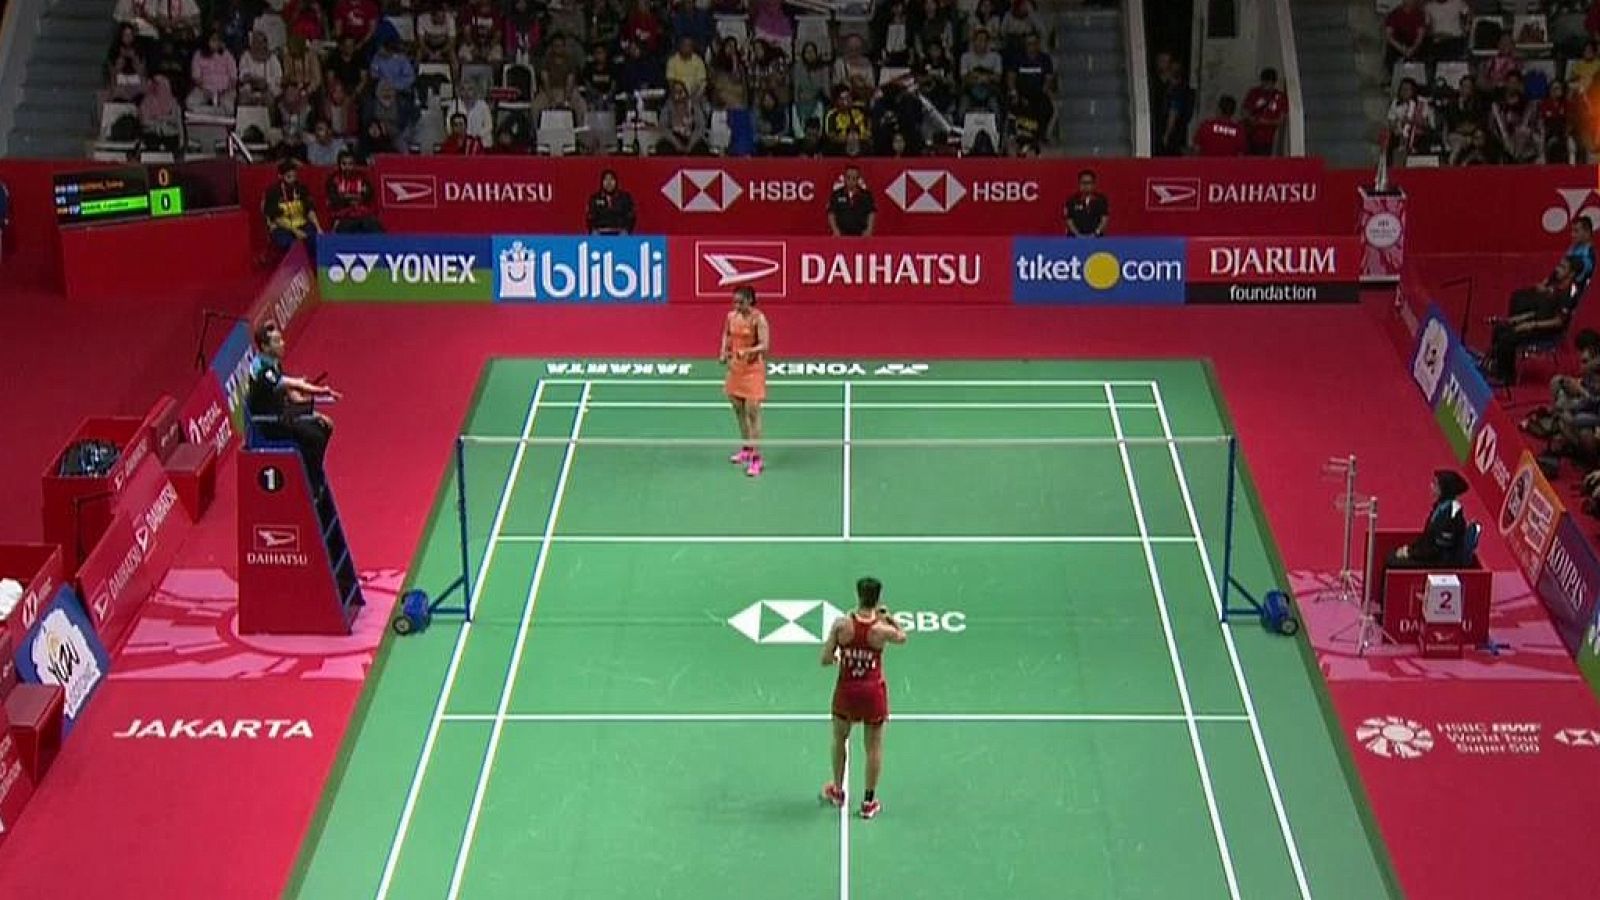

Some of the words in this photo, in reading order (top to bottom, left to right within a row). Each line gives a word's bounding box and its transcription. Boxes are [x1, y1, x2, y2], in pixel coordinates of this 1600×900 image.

[157, 168, 170, 187] 0
[160, 193, 171, 211] 0
[444, 182, 553, 203] DAIHATSU
[749, 181, 815, 203] HSBC
[973, 181, 1039, 203] HSBC
[1208, 183, 1317, 204] DAIHATSU
[385, 255, 476, 283] YONEX
[541, 240, 663, 298] blibli
[800, 253, 982, 286] DAIHATSU
[1209, 246, 1336, 275] DJARUM
[1229, 283, 1317, 302] foundation
[766, 363, 867, 375] YONEX
[263, 469, 275, 490] 1
[247, 553, 308, 566] DAIHATSU
[1547, 537, 1588, 612] KOMPAS
[1440, 590, 1453, 609] 2
[896, 610, 967, 632] SBC
[112, 719, 314, 739] JAKARTA
[1446, 732, 1501, 743] World
[1504, 732, 1541, 743] Tour
[1456, 743, 1506, 755] Super
[1509, 743, 1541, 753] 500
